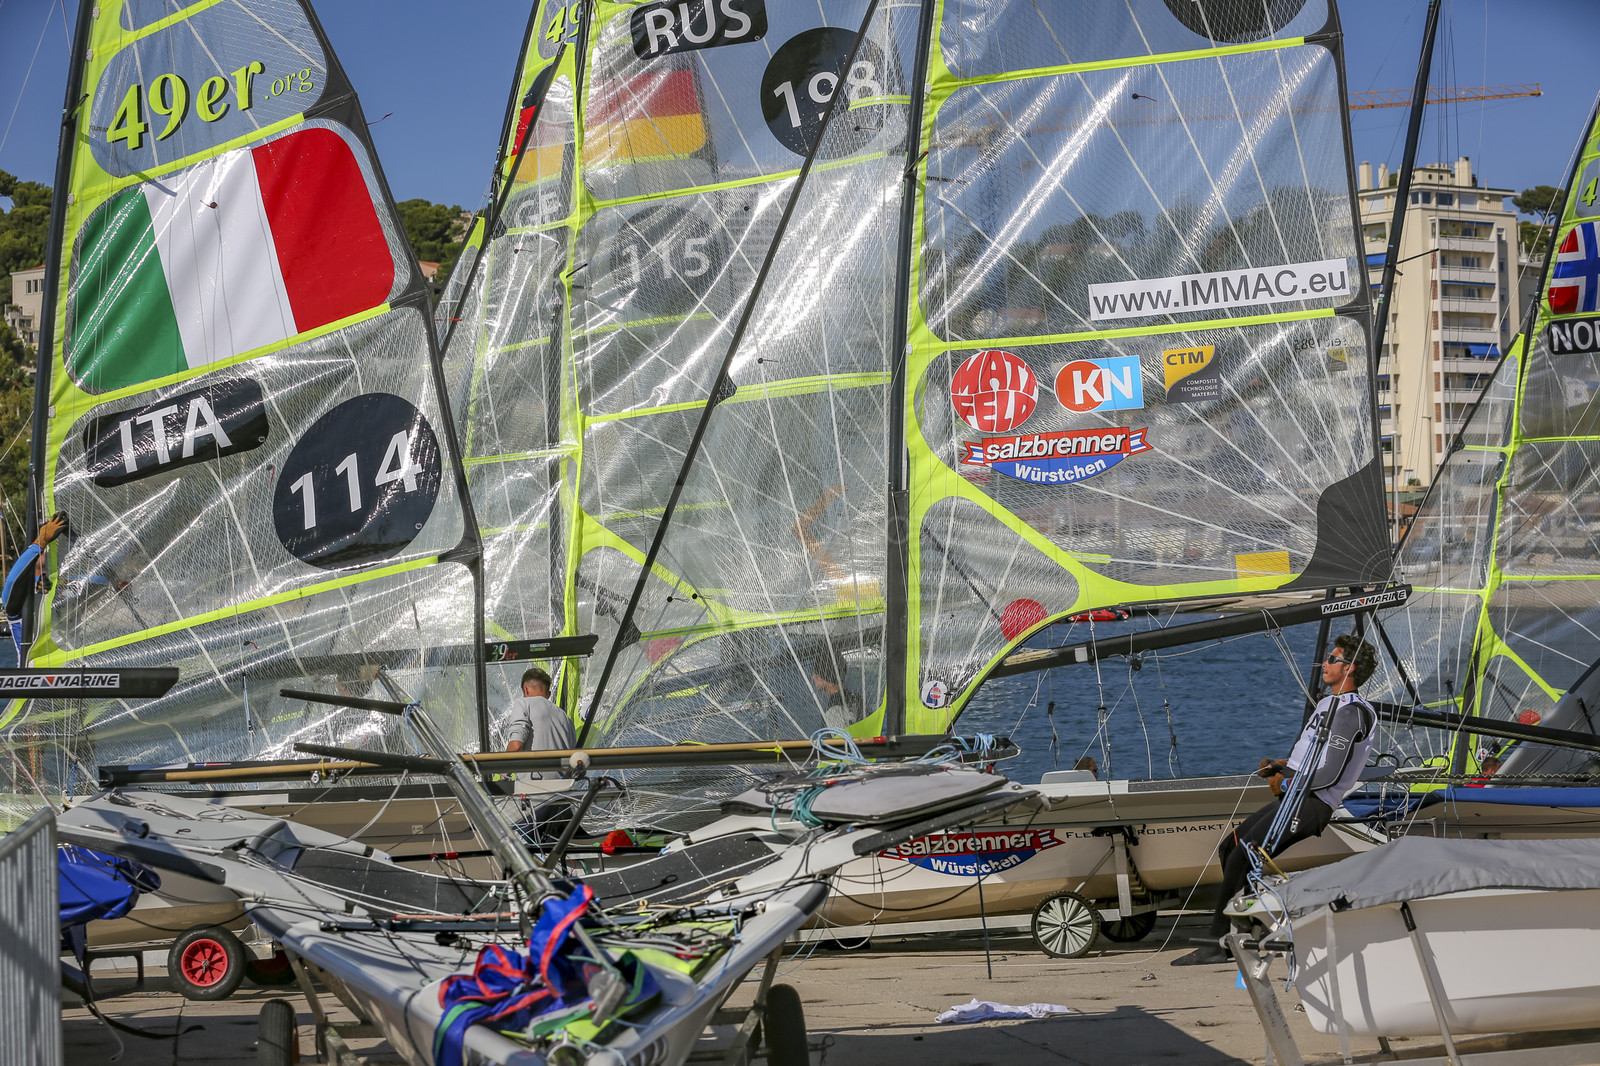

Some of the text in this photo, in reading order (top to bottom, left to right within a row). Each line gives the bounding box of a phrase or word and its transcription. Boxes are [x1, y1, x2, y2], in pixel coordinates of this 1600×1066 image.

[644, 0, 751, 54] RUS
[106, 61, 314, 150] 49er.org
[623, 237, 710, 282] 115
[1093, 270, 1347, 315] www.IMMAC.eu
[1166, 351, 1204, 365] CTM
[1072, 366, 1134, 405] KN
[951, 391, 1037, 432] FELD
[119, 395, 233, 473] ITA
[985, 434, 1128, 460] salzbrenner
[290, 430, 423, 530] 114
[1015, 458, 1106, 482] Würstchen
[1322, 590, 1406, 613] MAGIC MARINE
[899, 832, 1035, 856] salzbrenner
[930, 853, 1021, 875] Würstchen
